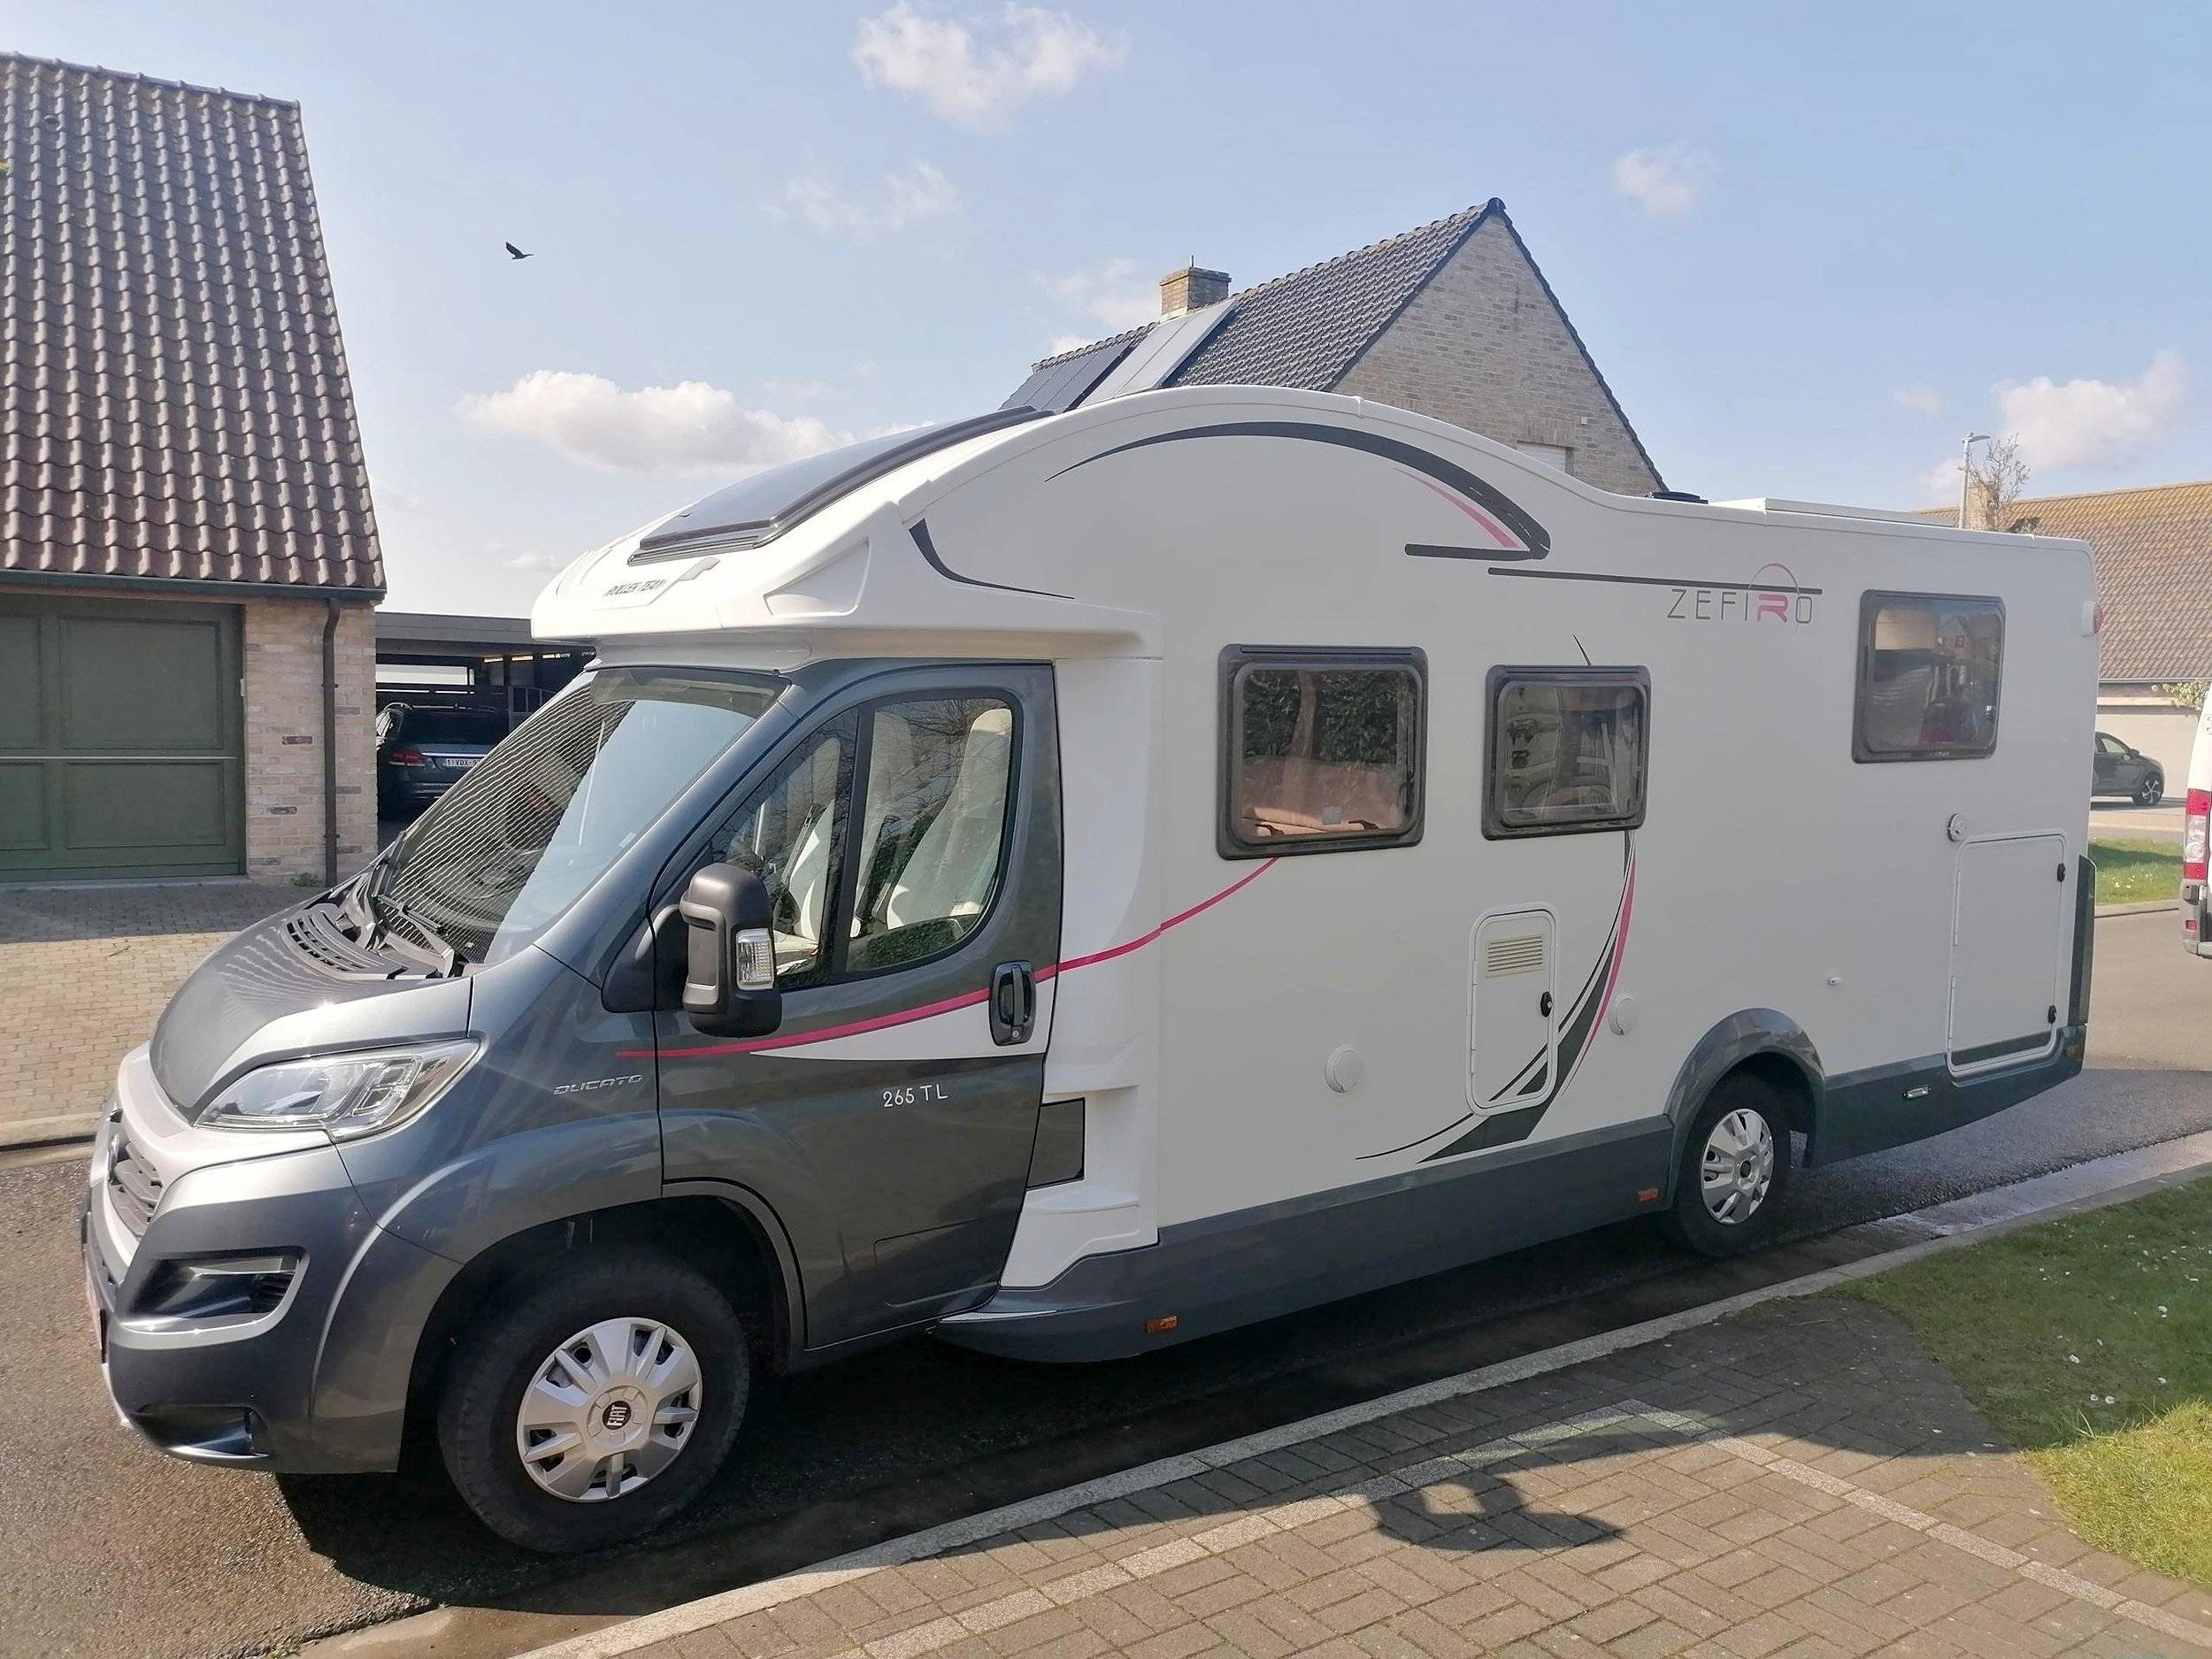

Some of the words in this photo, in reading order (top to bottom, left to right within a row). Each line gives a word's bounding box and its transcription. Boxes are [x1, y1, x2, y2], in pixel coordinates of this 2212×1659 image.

[1667, 588, 1813, 624] ZEFIRO
[553, 1074, 644, 1095] DUCATO
[882, 1087, 915, 1108] 265
[920, 1083, 949, 1102] TL
[606, 1404, 628, 1427] FIAT
